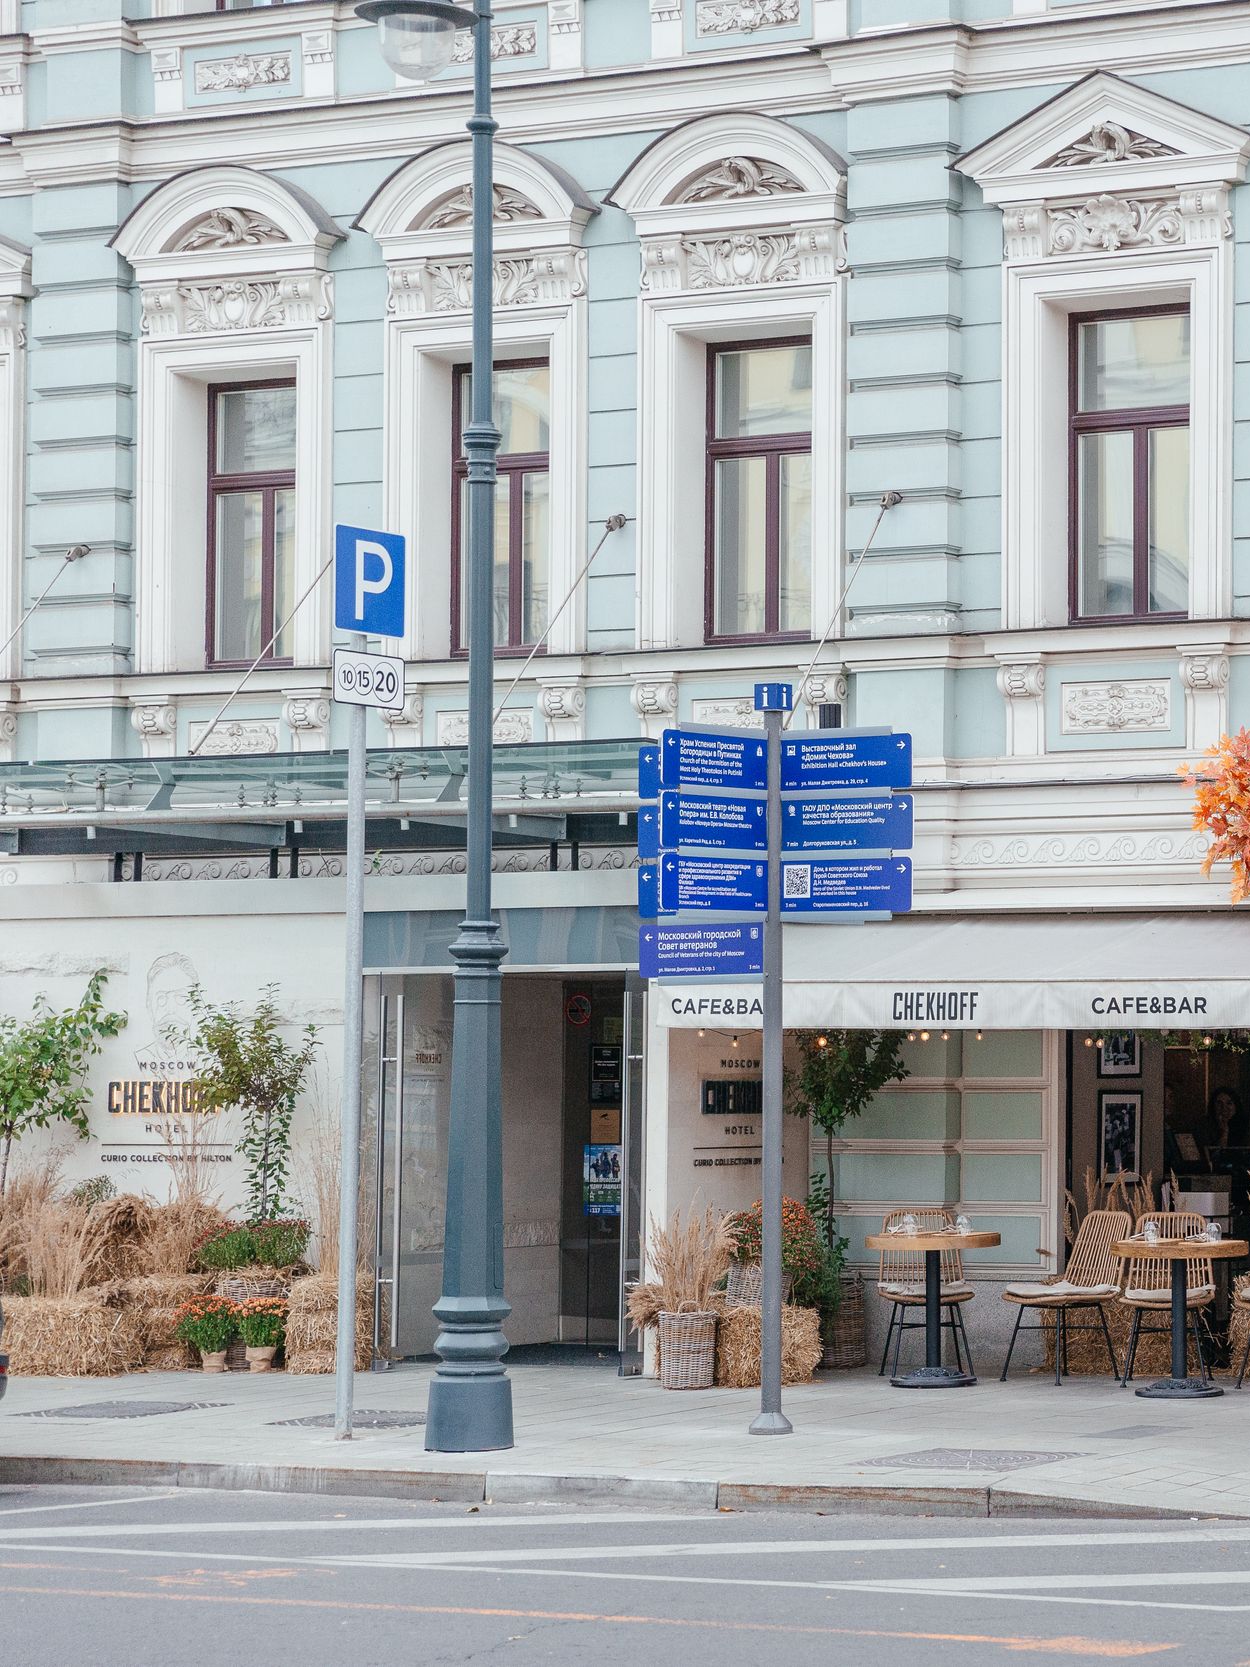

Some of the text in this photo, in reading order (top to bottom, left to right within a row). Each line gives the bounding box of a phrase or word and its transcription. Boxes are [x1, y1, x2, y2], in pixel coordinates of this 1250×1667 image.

[355, 540, 393, 620] P
[342, 670, 396, 693] 10 15 20
[680, 738, 694, 747] Храм
[717, 742, 744, 751] Пресвятой
[802, 744, 844, 752] Выставочный
[680, 747, 712, 757] Богородицы
[717, 751, 741, 759] Путинках
[802, 754, 827, 762] «Домик
[680, 801, 711, 810] Московский
[817, 804, 830, 812] ДПО
[680, 810, 699, 818] Опера»
[831, 811, 874, 819] образования»
[658, 930, 741, 940] Московский городской
[680, 942, 717, 950] ветеранов
[672, 998, 764, 1014] CAFE&BA
[893, 992, 978, 1020] CHEKHOFF
[1092, 997, 1207, 1014] CAFE&BAR
[140, 1062, 196, 1070] MOSCOW
[721, 1060, 760, 1068] MOSCOW
[108, 1081, 217, 1113] CHEKHO
[725, 1126, 755, 1135] HOTEL
